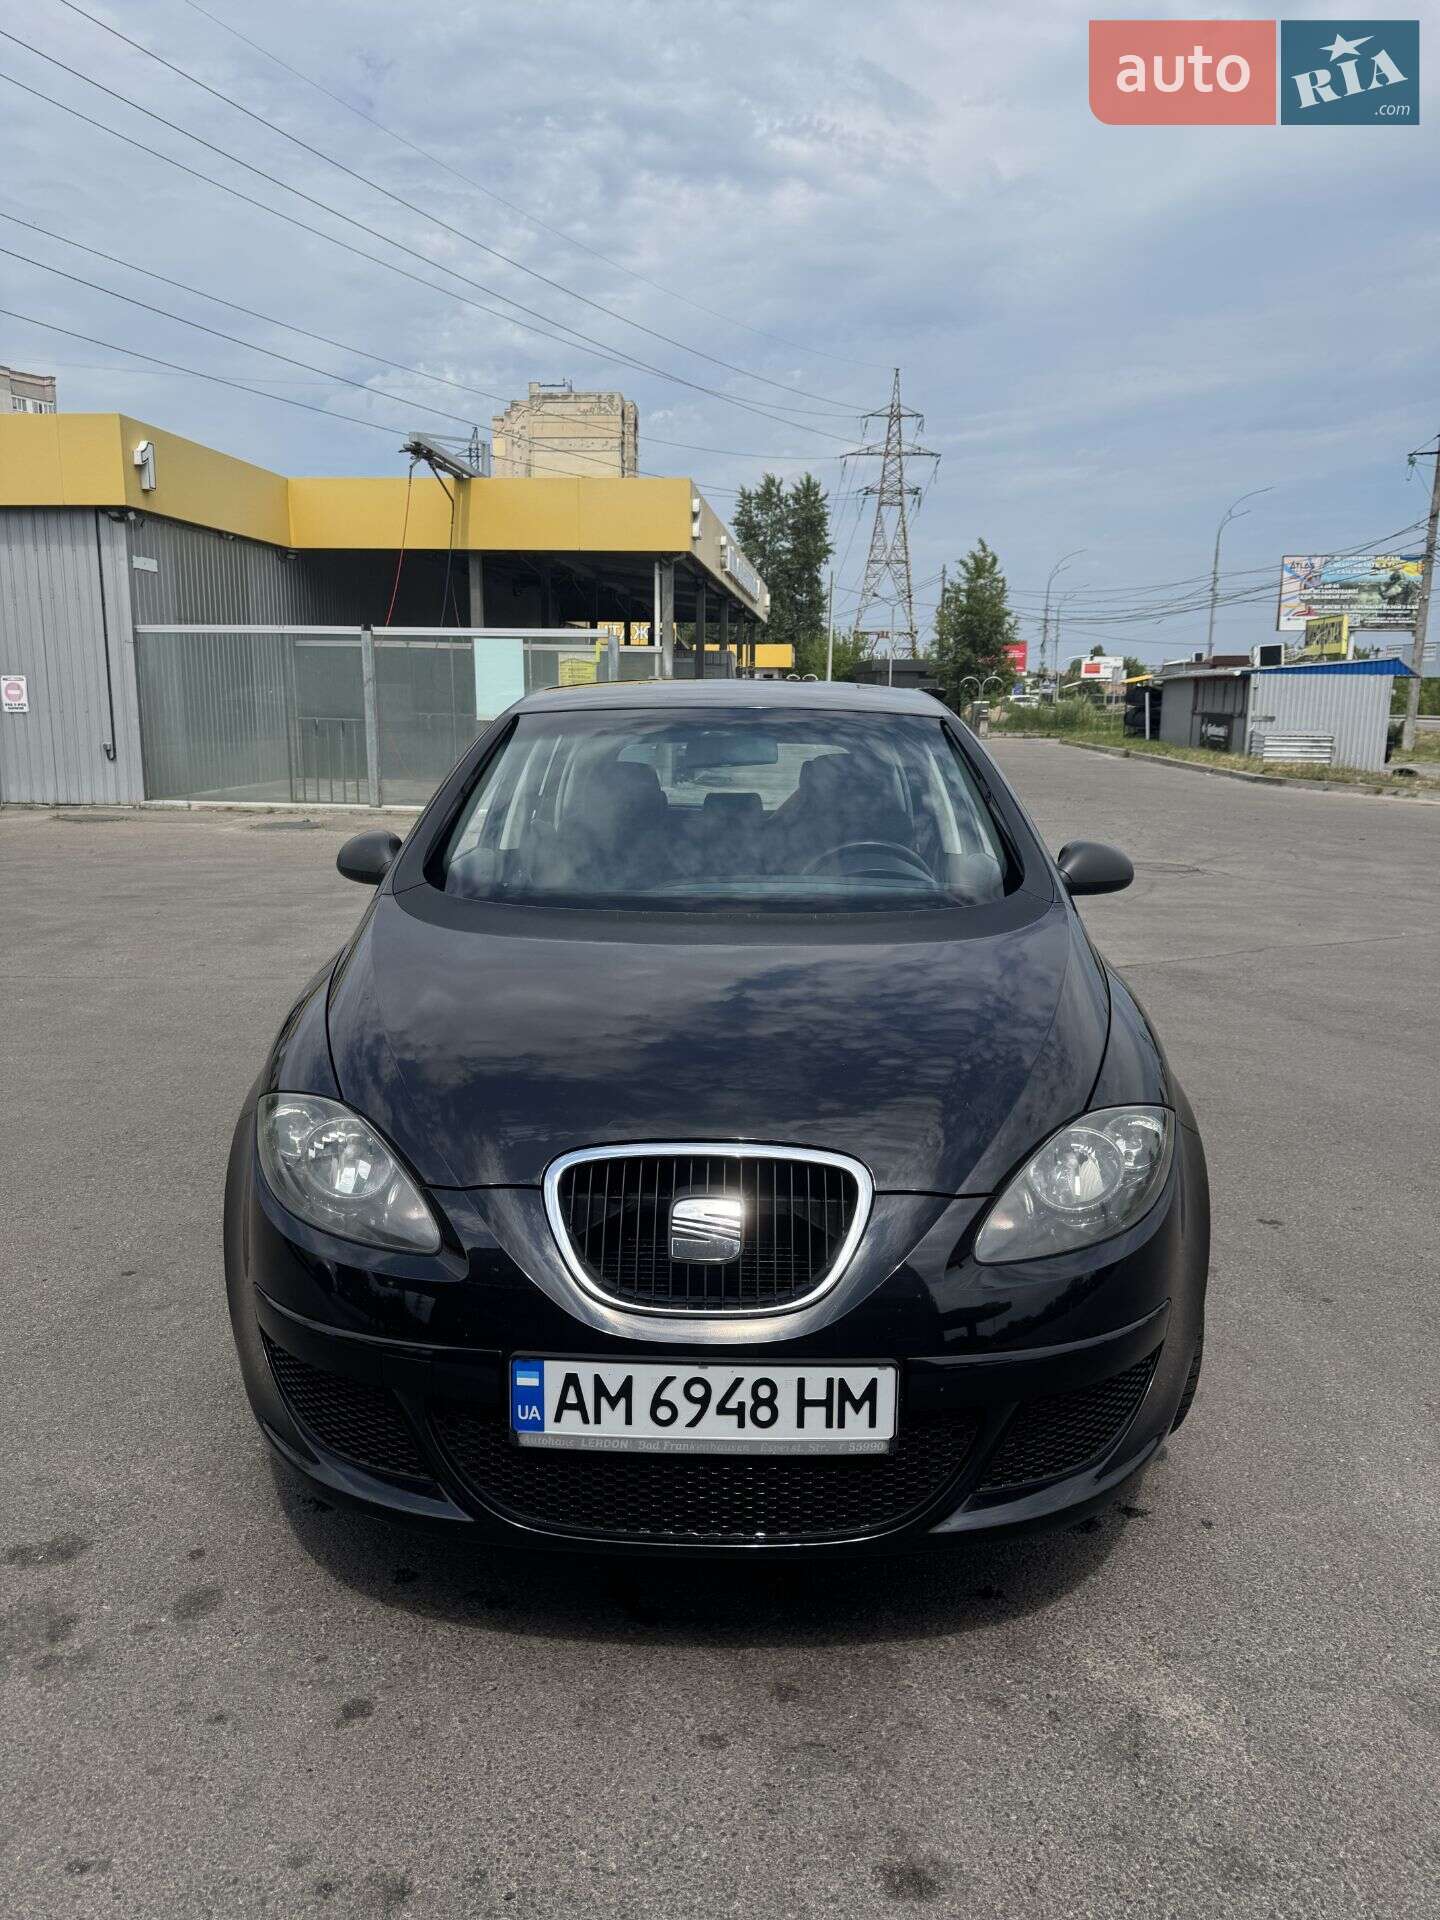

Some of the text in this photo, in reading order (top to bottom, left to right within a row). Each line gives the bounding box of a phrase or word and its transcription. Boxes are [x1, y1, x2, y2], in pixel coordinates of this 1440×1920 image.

[133, 440, 156, 490] 1
[518, 1404, 541, 1421] UA
[553, 1372, 877, 1429] AM 6948 HM
